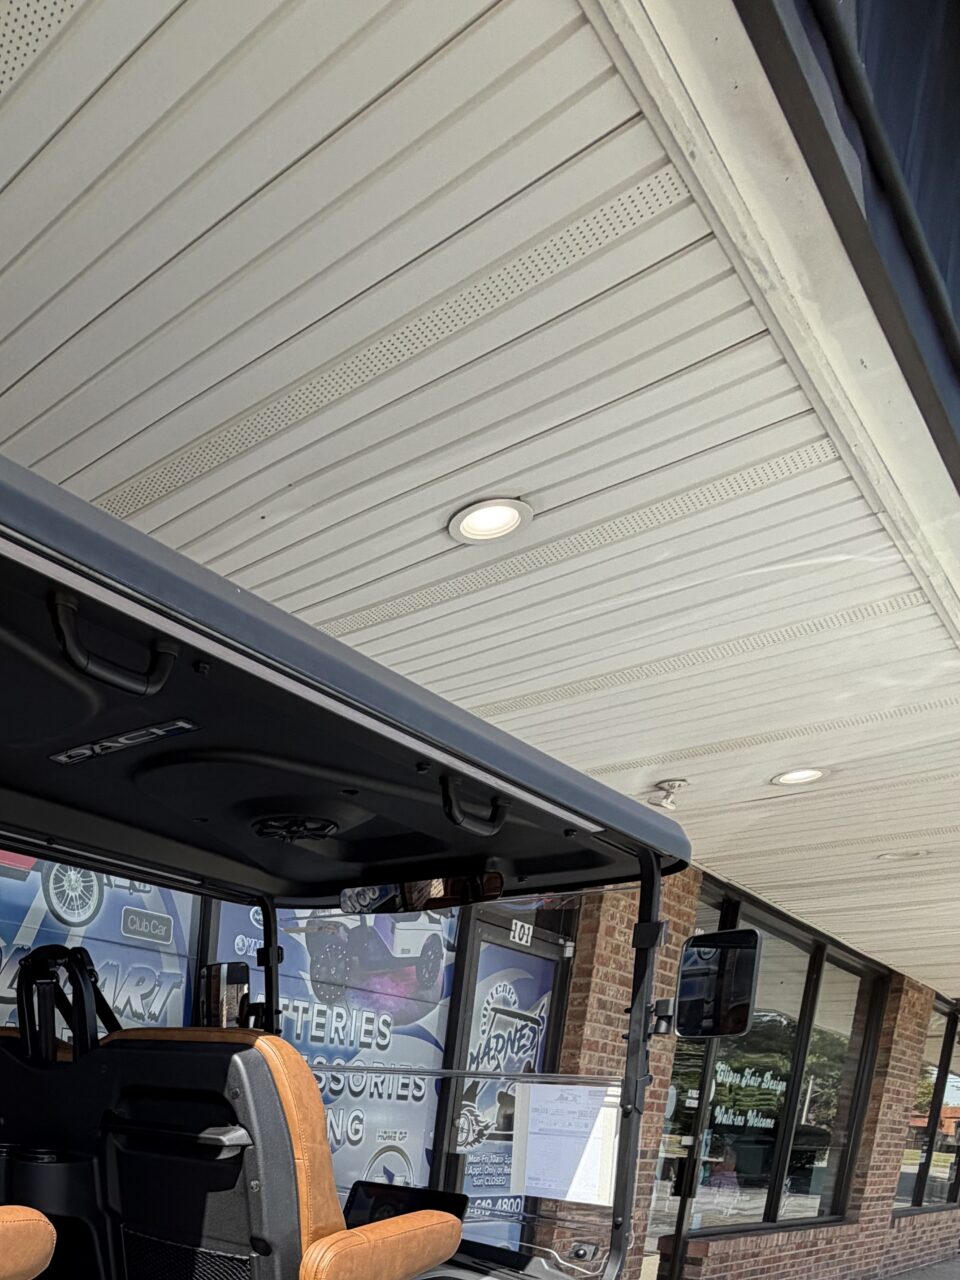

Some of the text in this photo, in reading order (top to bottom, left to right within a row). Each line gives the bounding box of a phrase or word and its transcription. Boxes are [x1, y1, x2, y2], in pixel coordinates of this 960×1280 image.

[127, 914, 167, 936] Club Car
[512, 921, 531, 944] 101
[746, 1109, 775, 1128] Welcome
